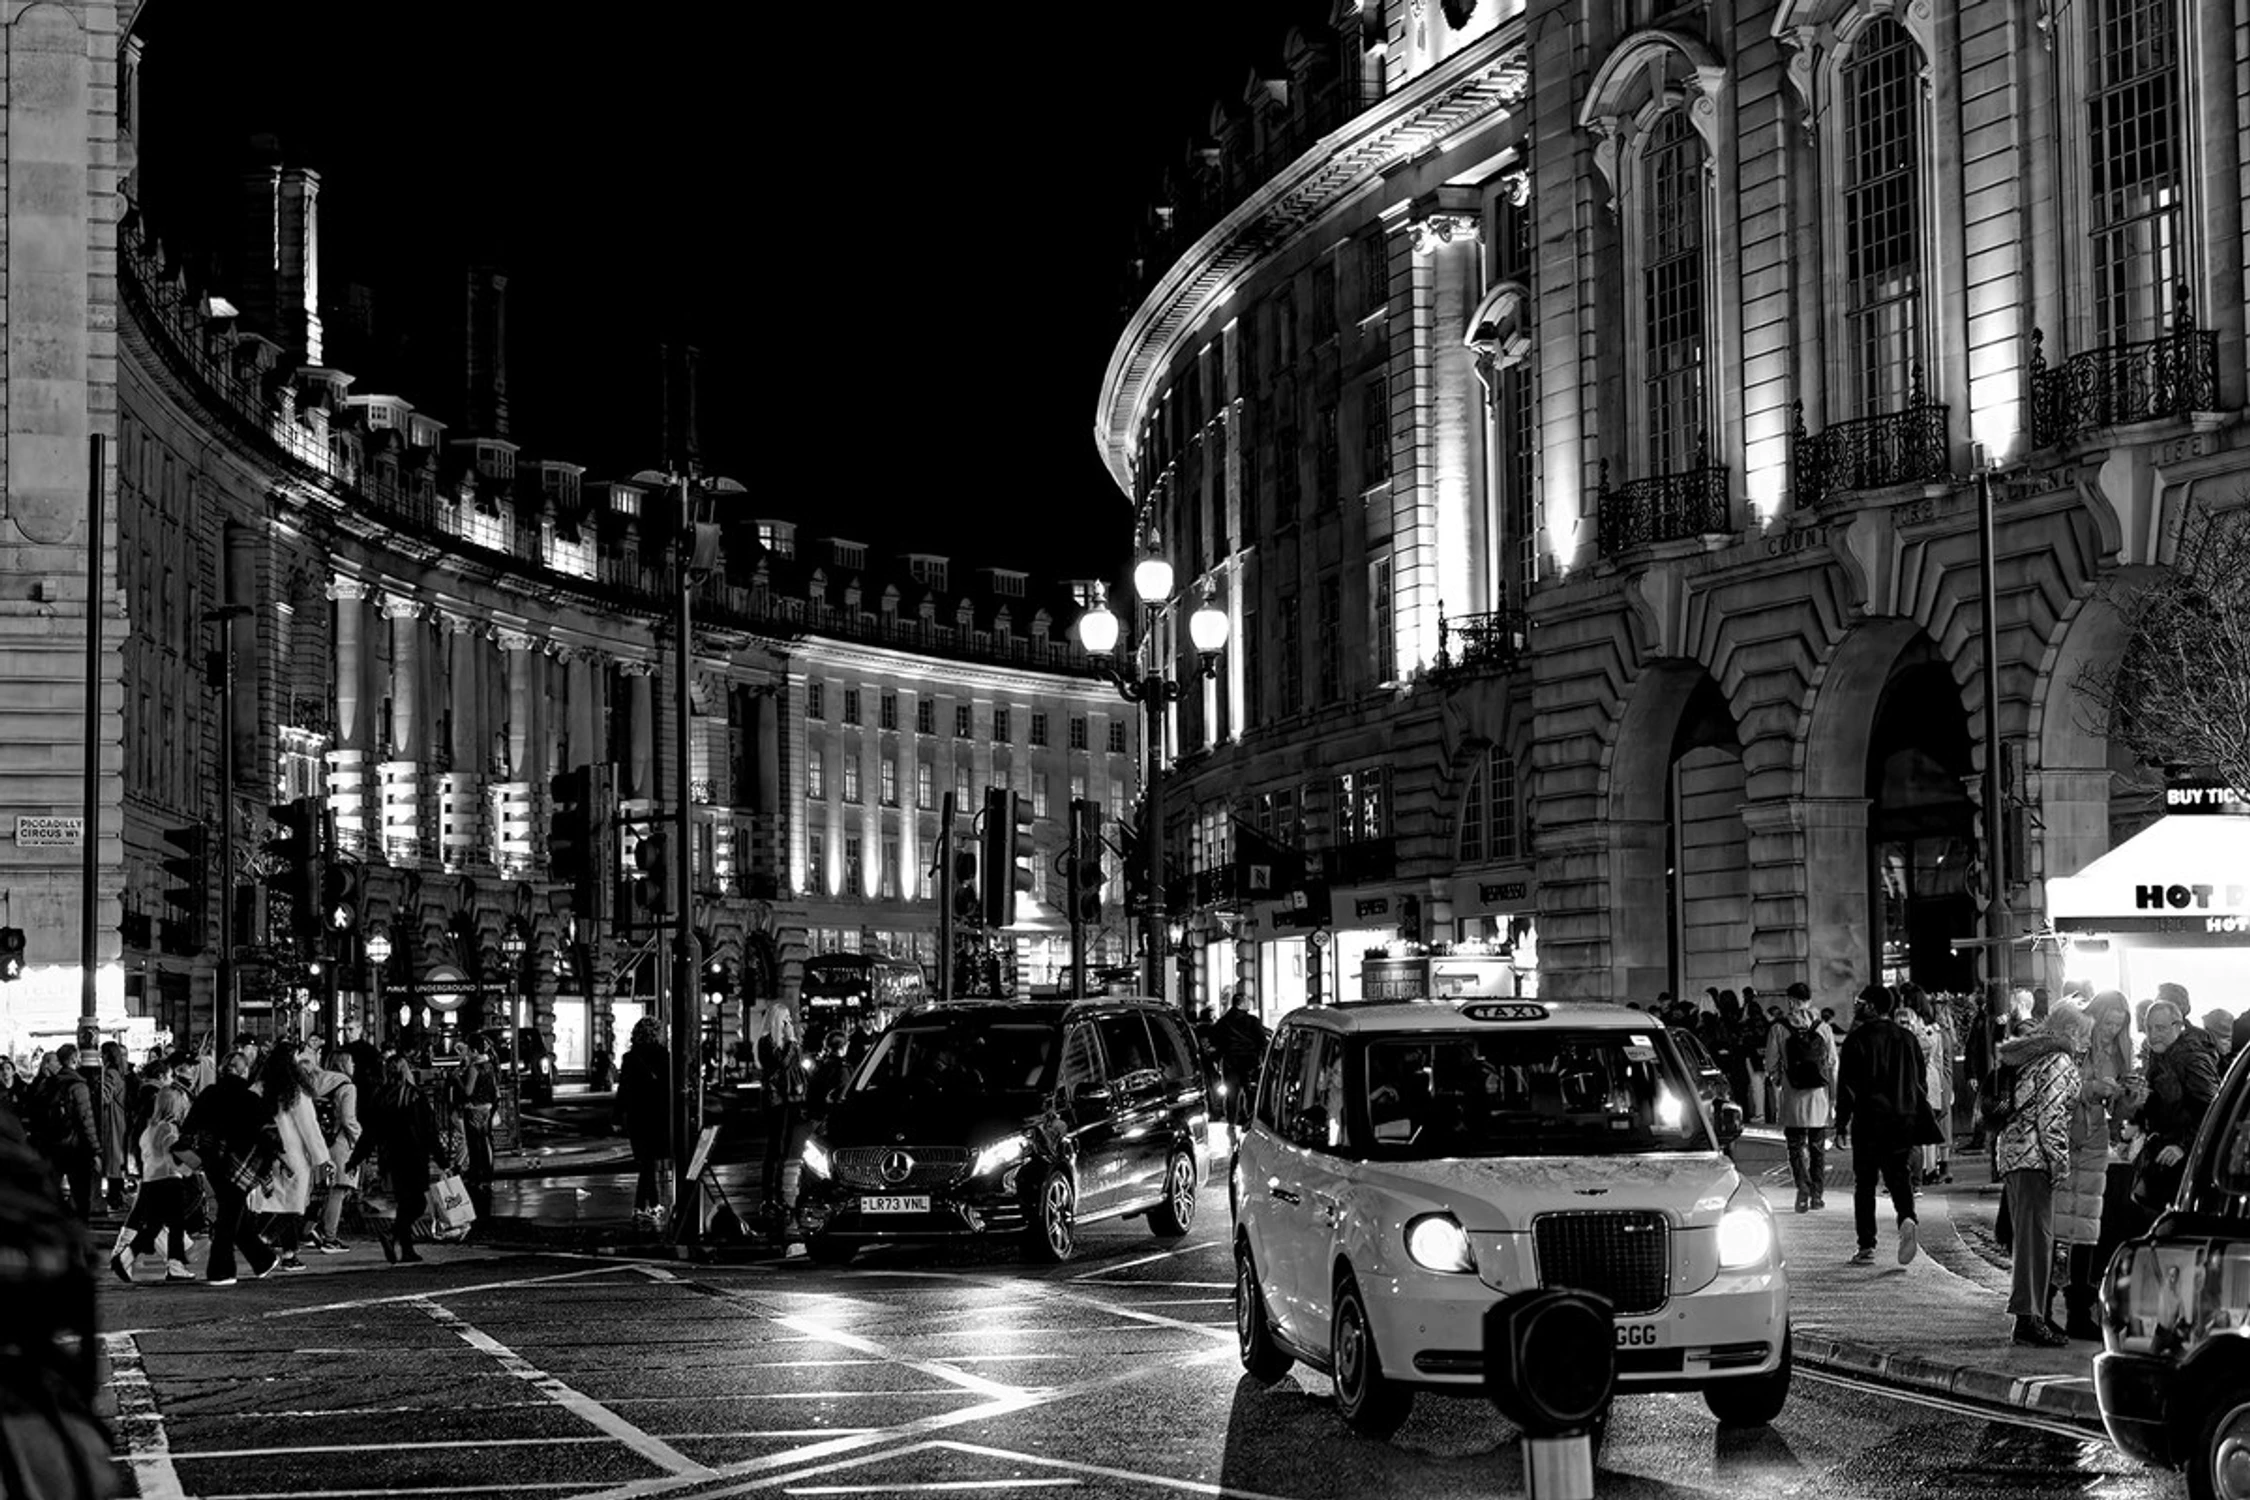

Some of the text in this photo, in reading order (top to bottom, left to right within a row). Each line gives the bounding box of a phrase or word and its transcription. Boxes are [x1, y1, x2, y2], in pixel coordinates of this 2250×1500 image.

[2167, 788, 2203, 805] BUY
[20, 819, 81, 829] PICCADILLY
[20, 828, 62, 838] CIRCUS
[2135, 884, 2214, 909] HOT
[2206, 915, 2250, 933] HOT
[414, 984, 477, 993] UNDERGROUND
[1479, 1006, 1537, 1019] TAXI
[869, 1197, 928, 1211] LR73 VNL
[1614, 1324, 1657, 1346] GGG
